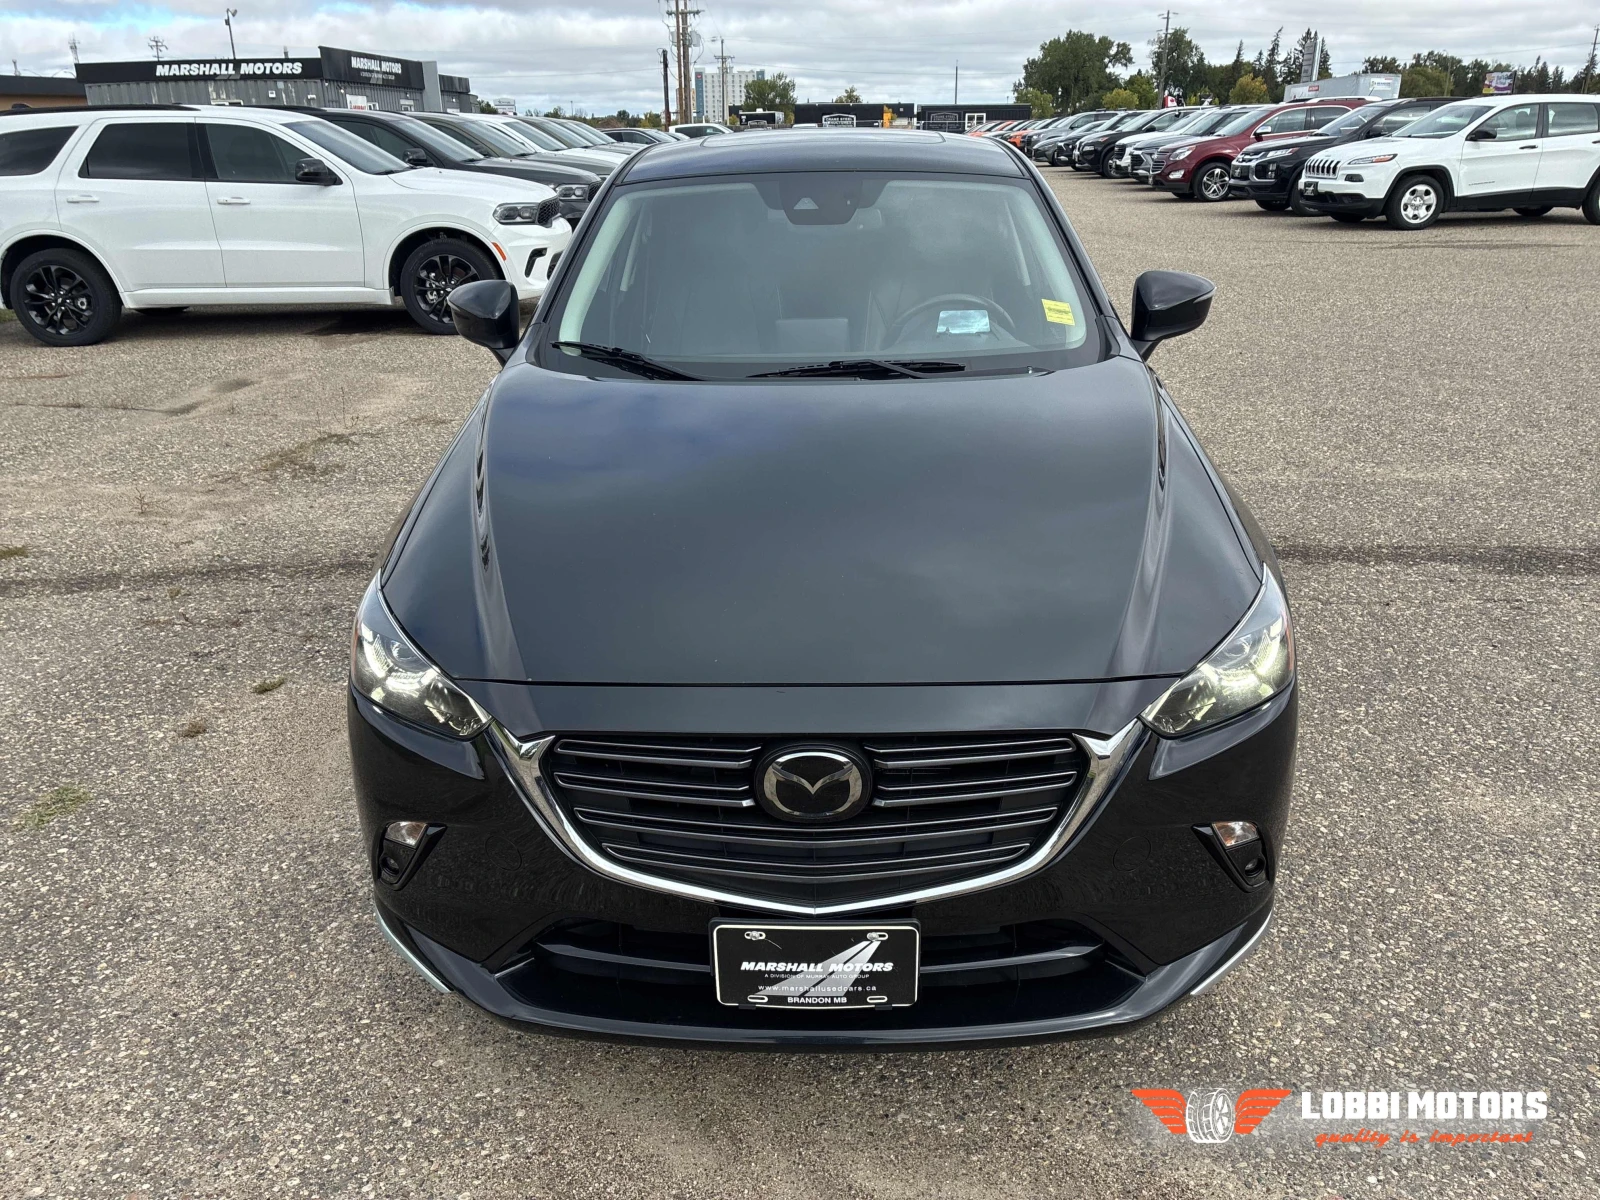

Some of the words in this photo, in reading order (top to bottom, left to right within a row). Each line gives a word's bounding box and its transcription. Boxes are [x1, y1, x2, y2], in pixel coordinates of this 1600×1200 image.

[155, 63, 236, 76] MARSHALL
[240, 62, 303, 75] MOTORS
[351, 56, 381, 72] MARSHALL
[381, 60, 402, 74] MOTORS
[740, 961, 824, 972] MARSHALL
[828, 962, 894, 972] MOTORS
